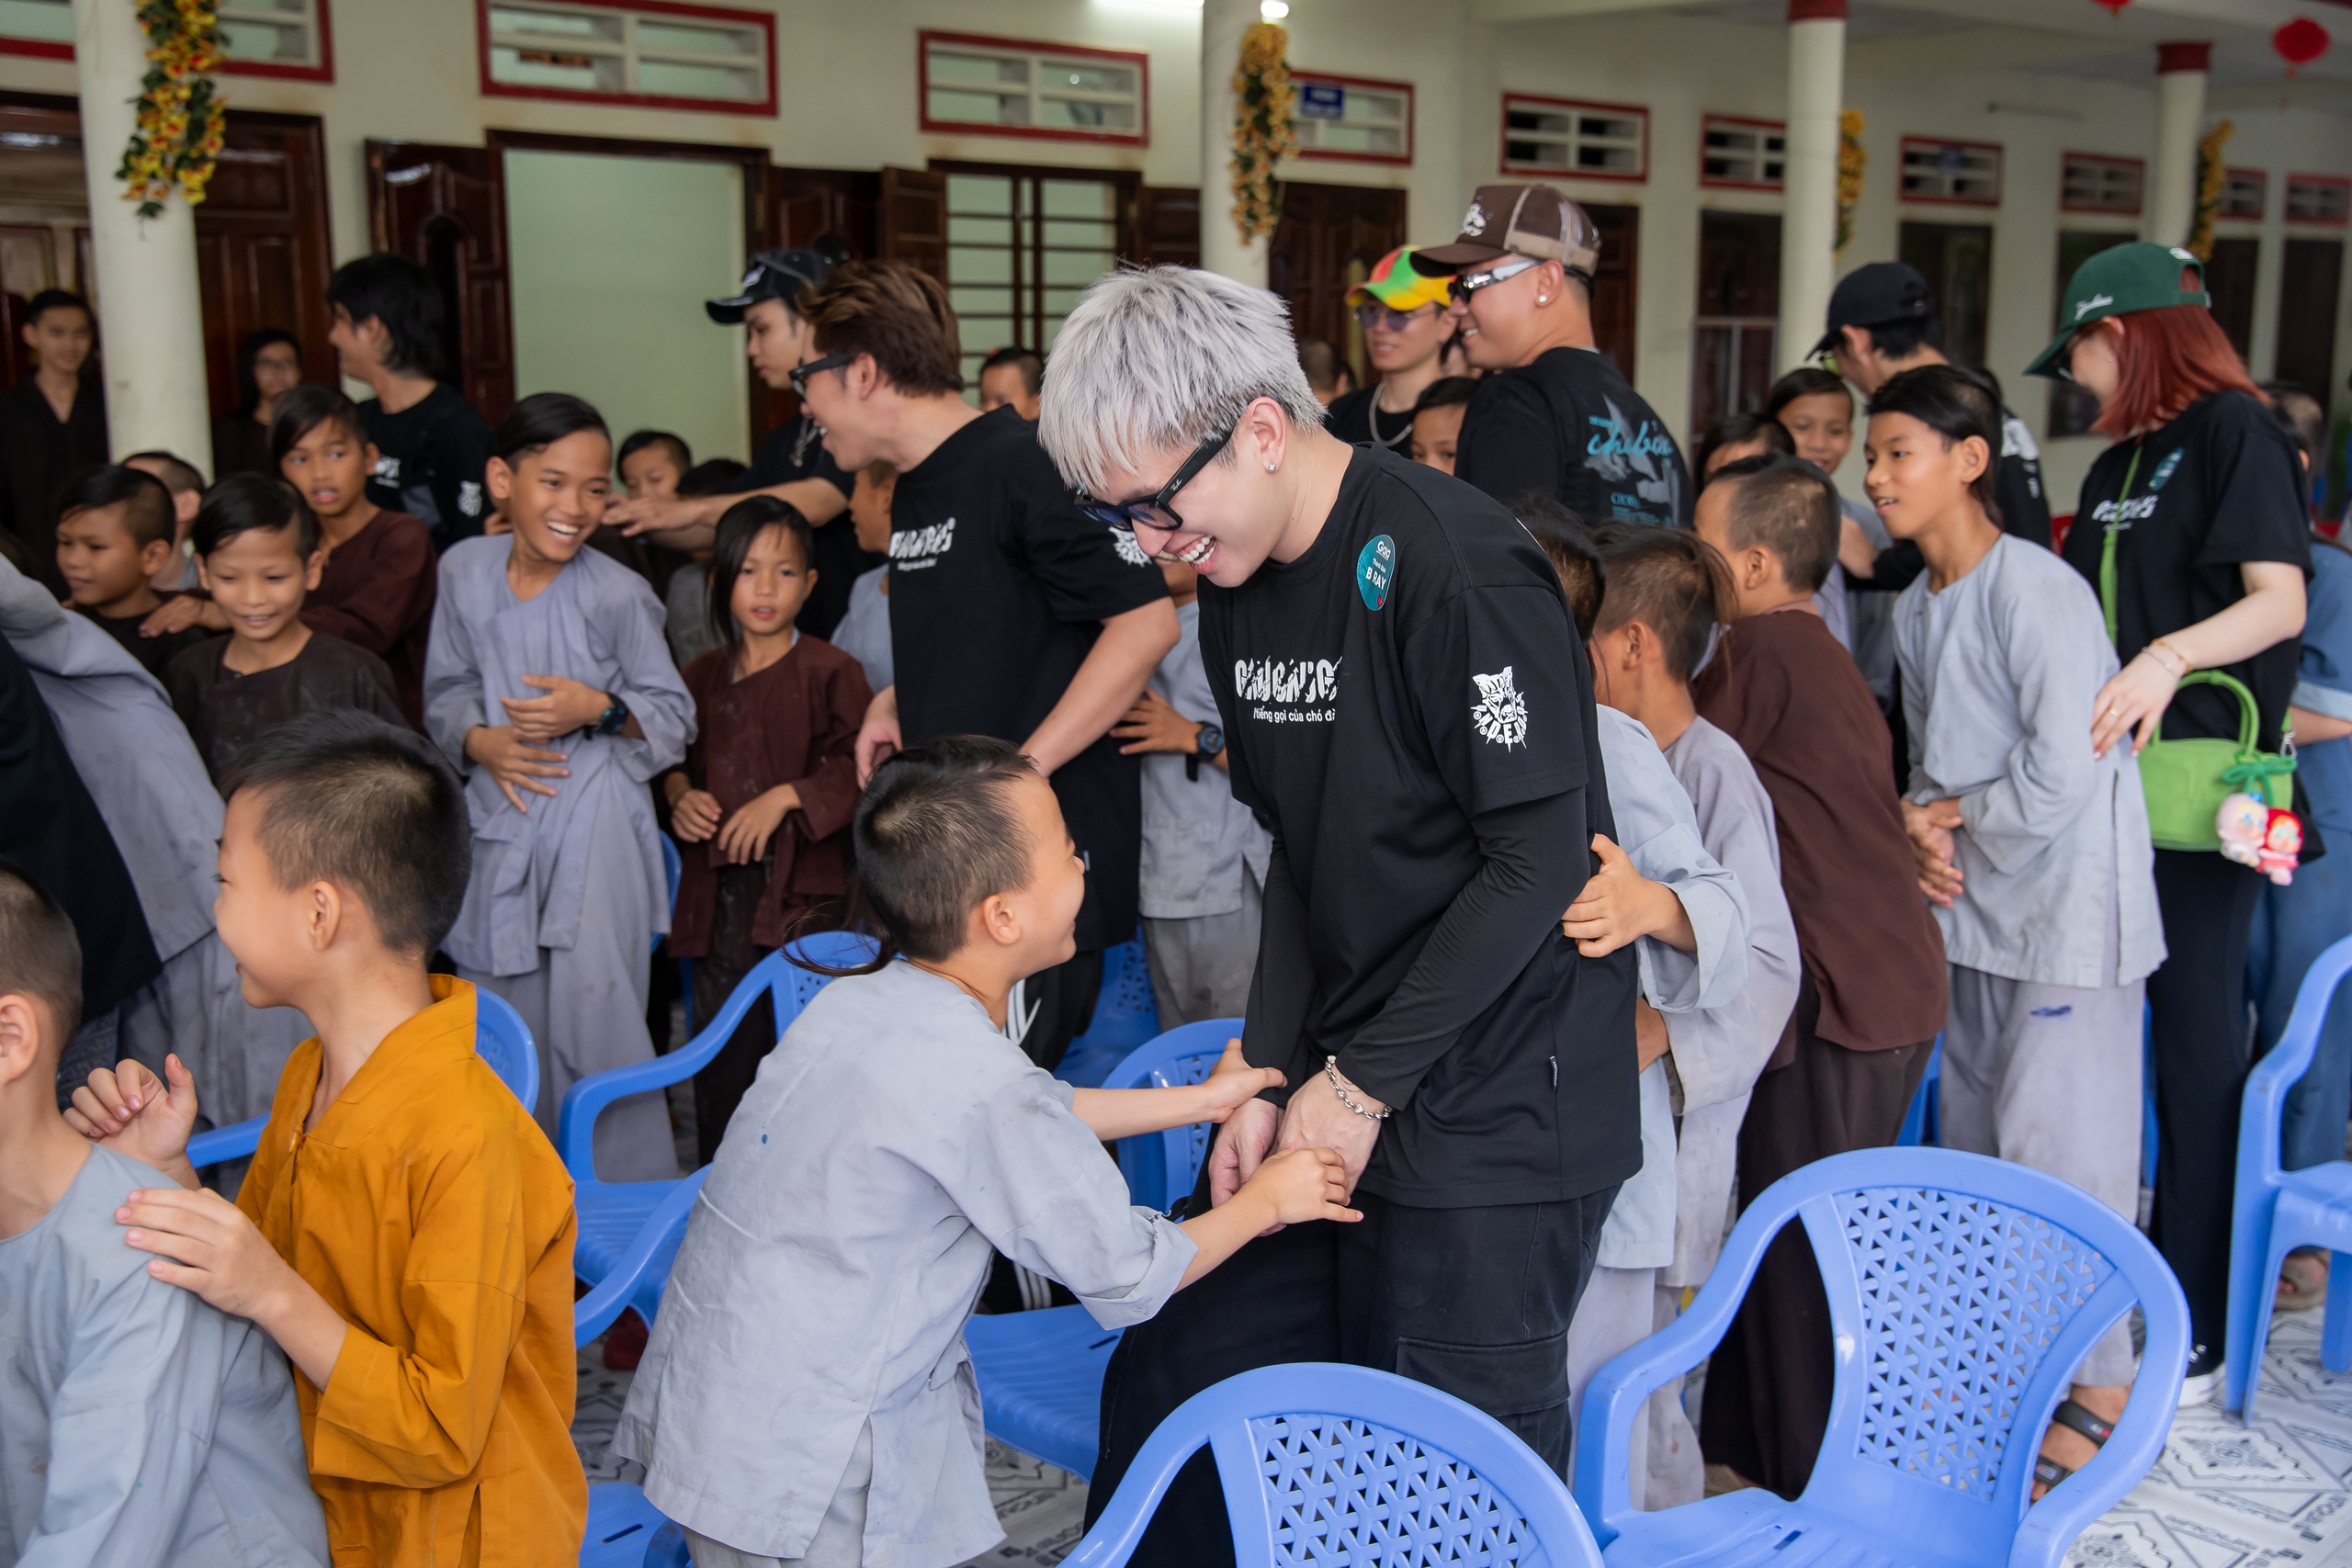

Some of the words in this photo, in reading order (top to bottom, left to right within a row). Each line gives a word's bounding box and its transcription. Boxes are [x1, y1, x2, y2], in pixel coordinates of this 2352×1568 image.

[1365, 566, 1373, 581] B
[1372, 571, 1386, 590] RAY
[1273, 708, 1286, 724] gọi
[1288, 708, 1304, 722] của
[1306, 708, 1322, 722] chó
